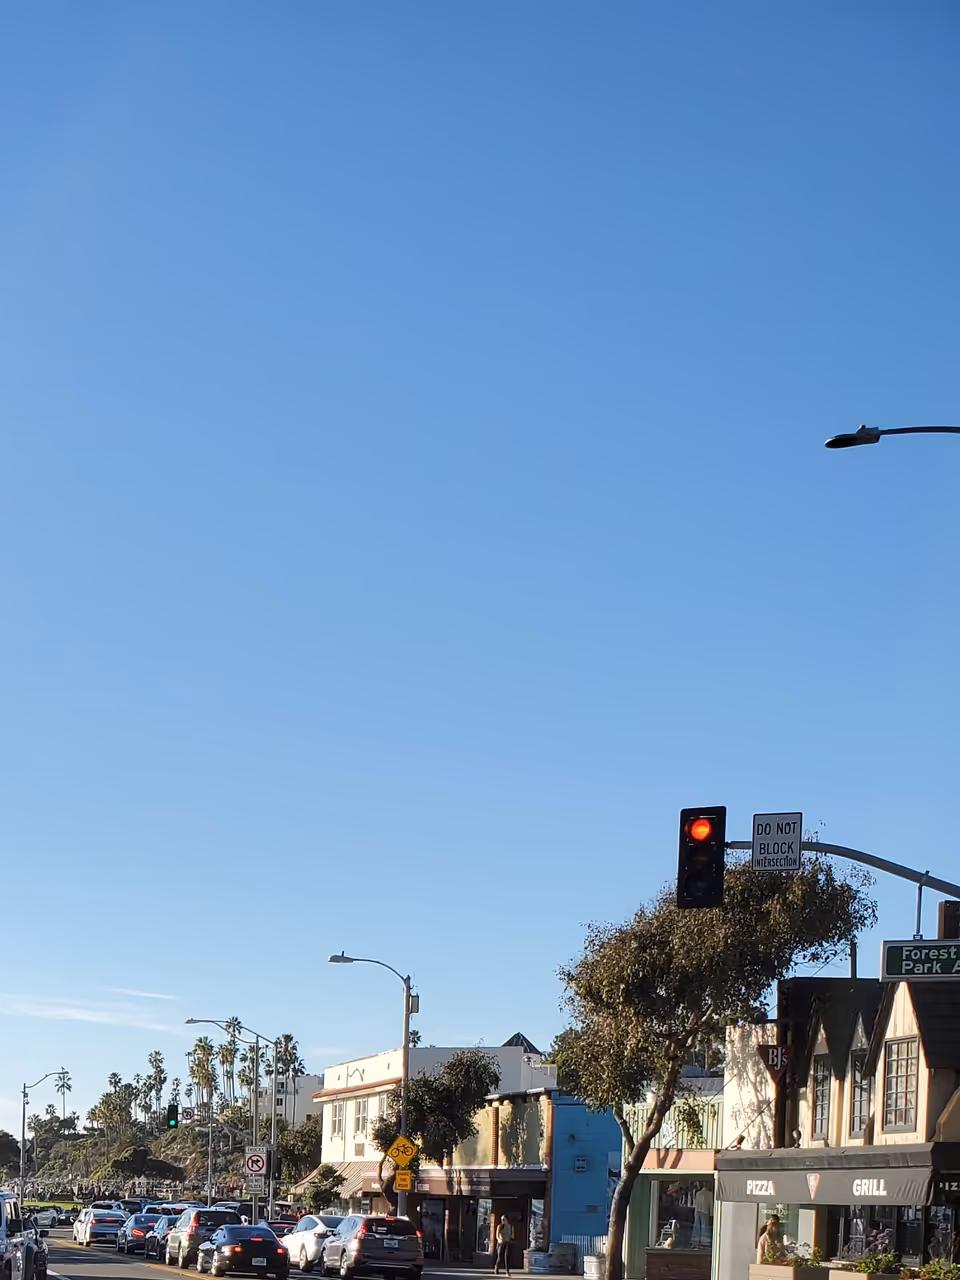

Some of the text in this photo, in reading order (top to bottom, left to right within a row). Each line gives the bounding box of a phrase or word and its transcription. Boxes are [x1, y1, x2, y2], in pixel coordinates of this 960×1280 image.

[756, 821, 797, 836] DO NOT
[759, 841, 794, 855] BLOCK
[754, 856, 797, 868] INTERSECTION
[902, 946, 957, 960] Forest
[901, 960, 942, 973] Park
[768, 1046, 788, 1070] BJ's
[746, 1178, 887, 1196] PIZZA GRILL
